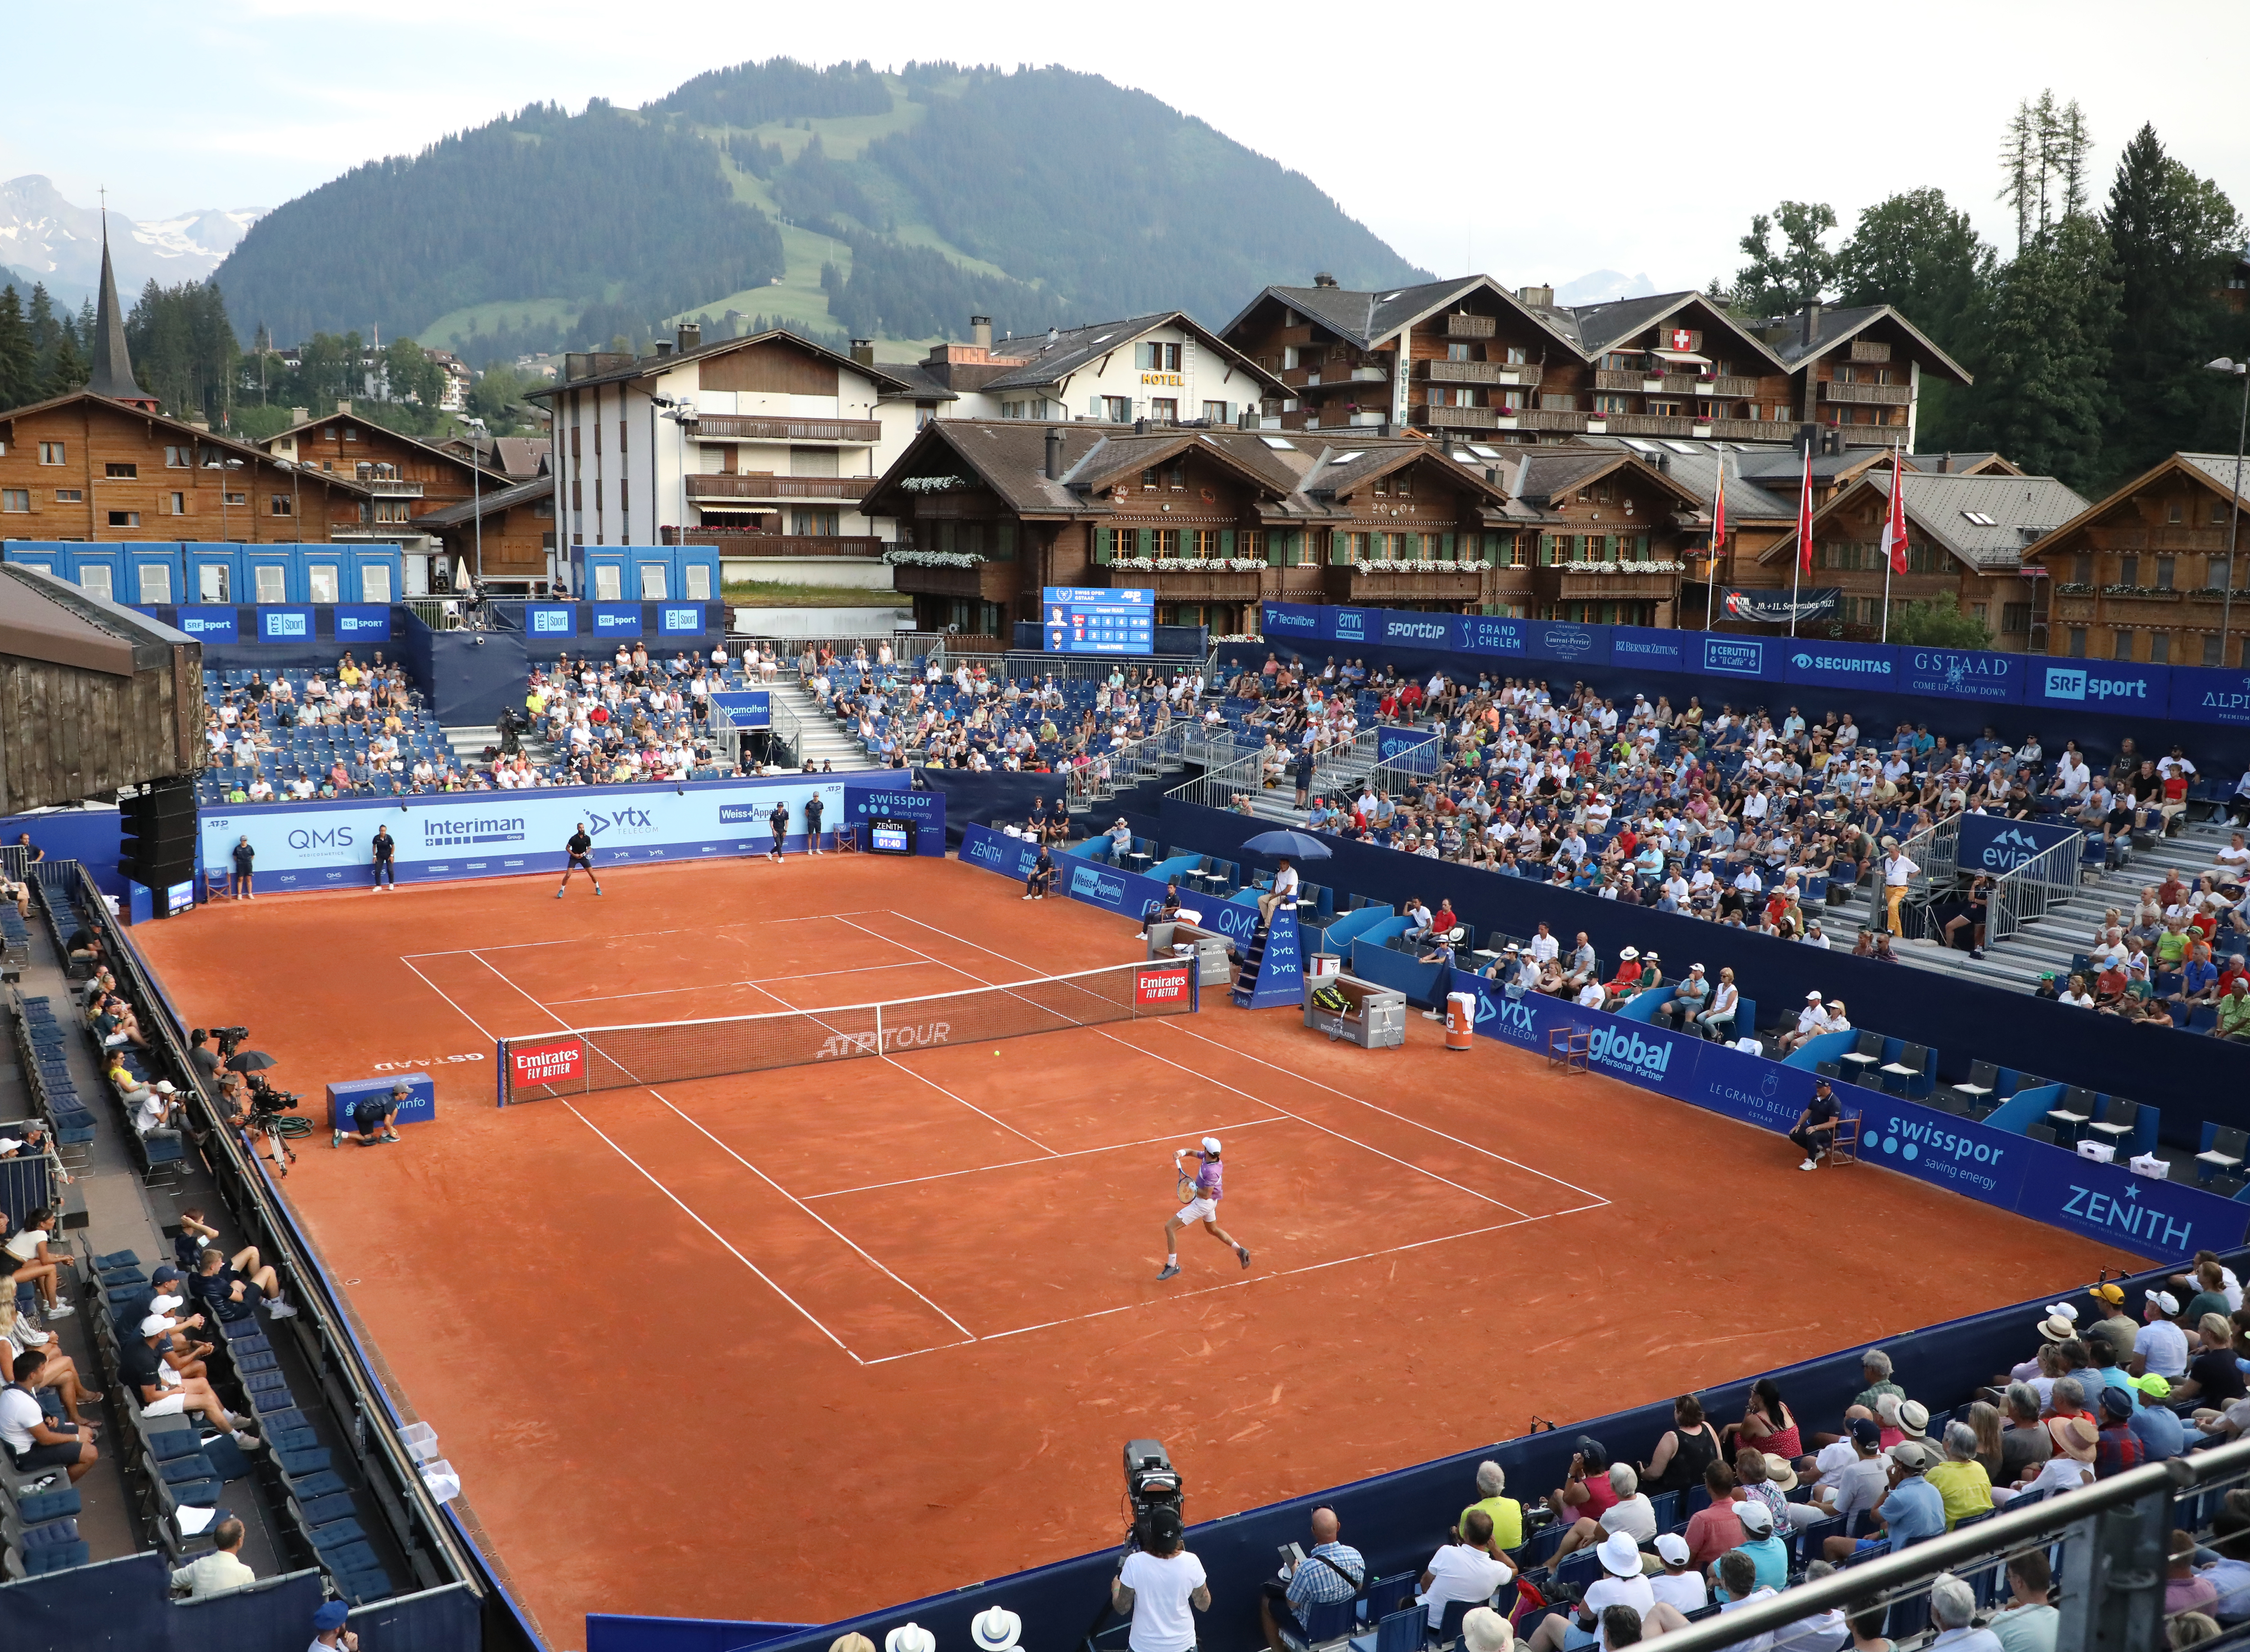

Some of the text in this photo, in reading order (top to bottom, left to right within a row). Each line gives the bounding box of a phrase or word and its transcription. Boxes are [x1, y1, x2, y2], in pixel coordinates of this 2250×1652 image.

[1142, 373, 1184, 386] HOTEL
[205, 621, 231, 630] sport
[285, 619, 304, 630] Sport
[550, 616, 566, 627] Sport
[615, 616, 636, 625] sport
[680, 615, 696, 624] Sport
[1278, 614, 1314, 627] Tecnifibre
[1479, 624, 1515, 636] GRAND
[1479, 636, 1520, 649] CHELEM
[1546, 635, 1589, 646] Laurent-Perrier
[1616, 641, 1678, 655] BZ BERNER ZEITUNG
[1718, 646, 1749, 657] CERUTTI
[1815, 656, 1890, 673] SECURITAS
[1913, 681, 2006, 697] COME UP SLOW DOWN
[2050, 675, 2146, 700] SRF sport
[869, 792, 932, 808] swisspor
[612, 807, 652, 826] vtx
[913, 811, 932, 819] energy
[425, 817, 524, 835] Interiman
[617, 826, 658, 835] TELECOM
[877, 822, 903, 830] ZENITH
[288, 827, 353, 849] QMS
[879, 838, 900, 848] 01:40
[971, 840, 1003, 863] ZENITH
[1983, 847, 2045, 874] evian
[1075, 872, 1121, 898] Weiss+Appetito
[1281, 964, 1296, 972] vtx
[1140, 976, 1185, 989] Emirates
[1146, 987, 1178, 998] FLY BETTER
[1316, 990, 1339, 1009] Babolat
[1501, 999, 1537, 1032] vtx
[816, 1022, 950, 1058] ATP TOUR
[1499, 1023, 1537, 1042] TELECOM
[1588, 1025, 1673, 1072] global
[516, 1049, 579, 1069] Emirates
[527, 1063, 570, 1080] FLY BETTER
[1601, 1055, 1664, 1082] Personal Partner
[1710, 1082, 1721, 1094] LE
[1725, 1088, 1764, 1108] GRAND
[1748, 1111, 1773, 1123] GSTAAD
[1888, 1116, 2004, 1165] swisspor
[1924, 1157, 1996, 1190] saving energy
[2061, 1185, 2192, 1250] ZENITH
